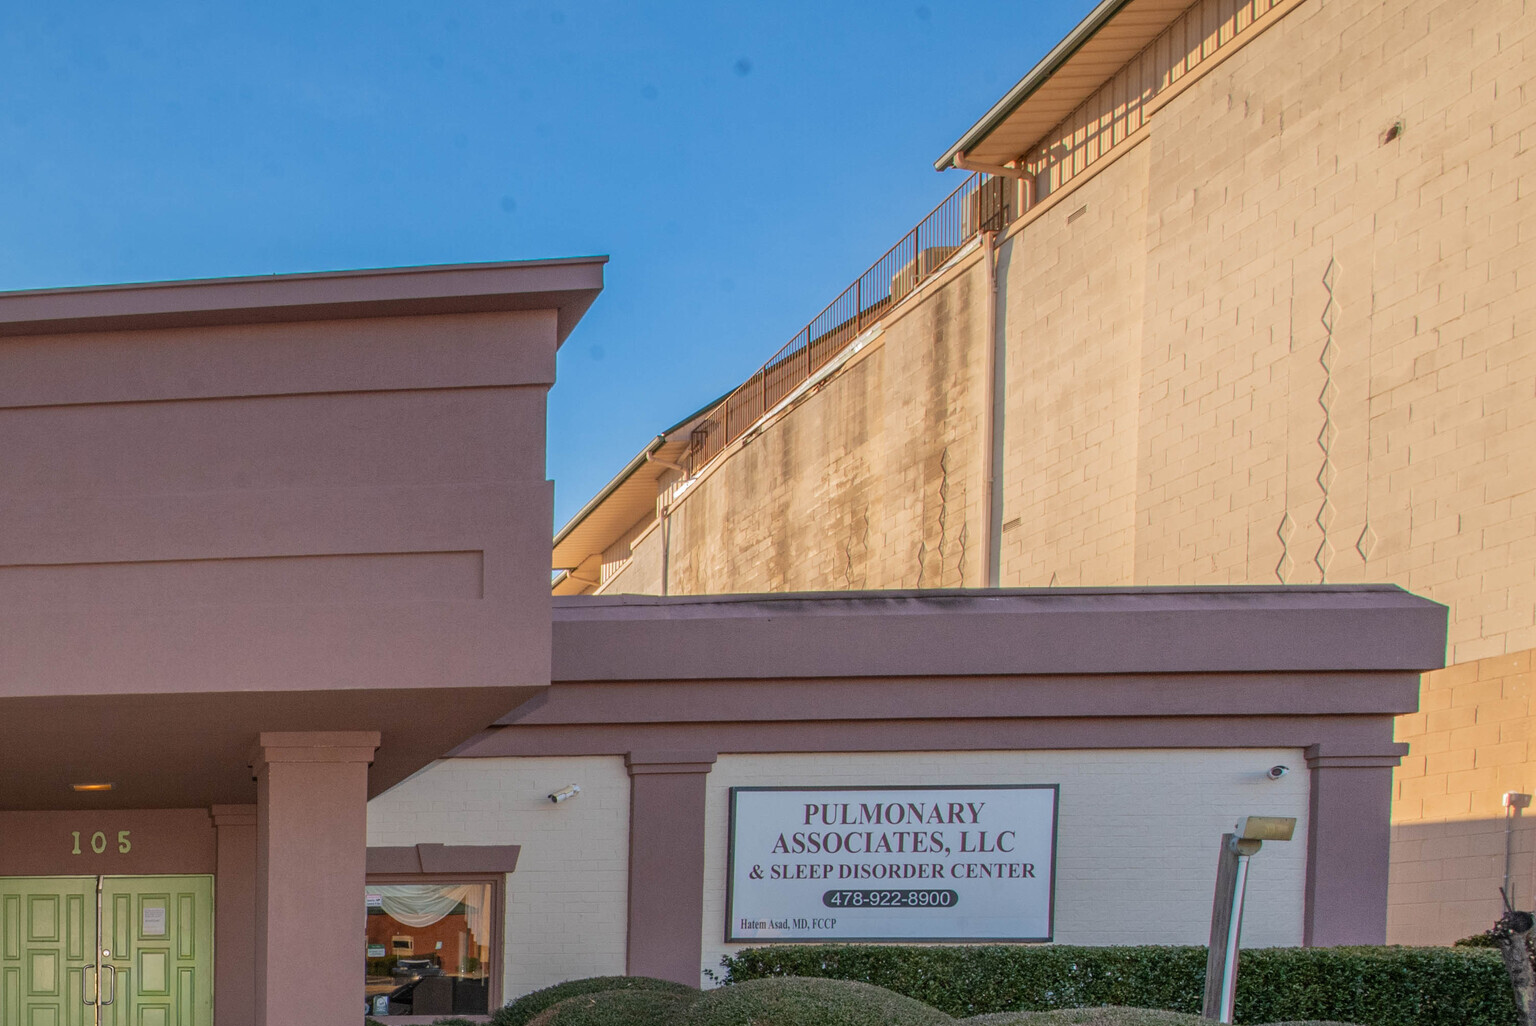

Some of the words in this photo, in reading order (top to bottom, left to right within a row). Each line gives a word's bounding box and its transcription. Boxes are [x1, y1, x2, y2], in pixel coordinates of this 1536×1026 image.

[803, 802, 985, 825] PULMONARY
[71, 831, 132, 854] 105
[771, 831, 951, 857] ASSOCIATES,
[958, 830, 1016, 853] LLC
[749, 864, 764, 880] &
[771, 864, 834, 880] SLEEP
[839, 863, 945, 879] DISORDER
[951, 863, 1036, 879] CENTER
[831, 891, 950, 906] 478-922-8900
[740, 919, 767, 929] Hatem
[768, 919, 790, 931] Asad,
[792, 919, 810, 931] MD,
[812, 918, 837, 929] FCCP
